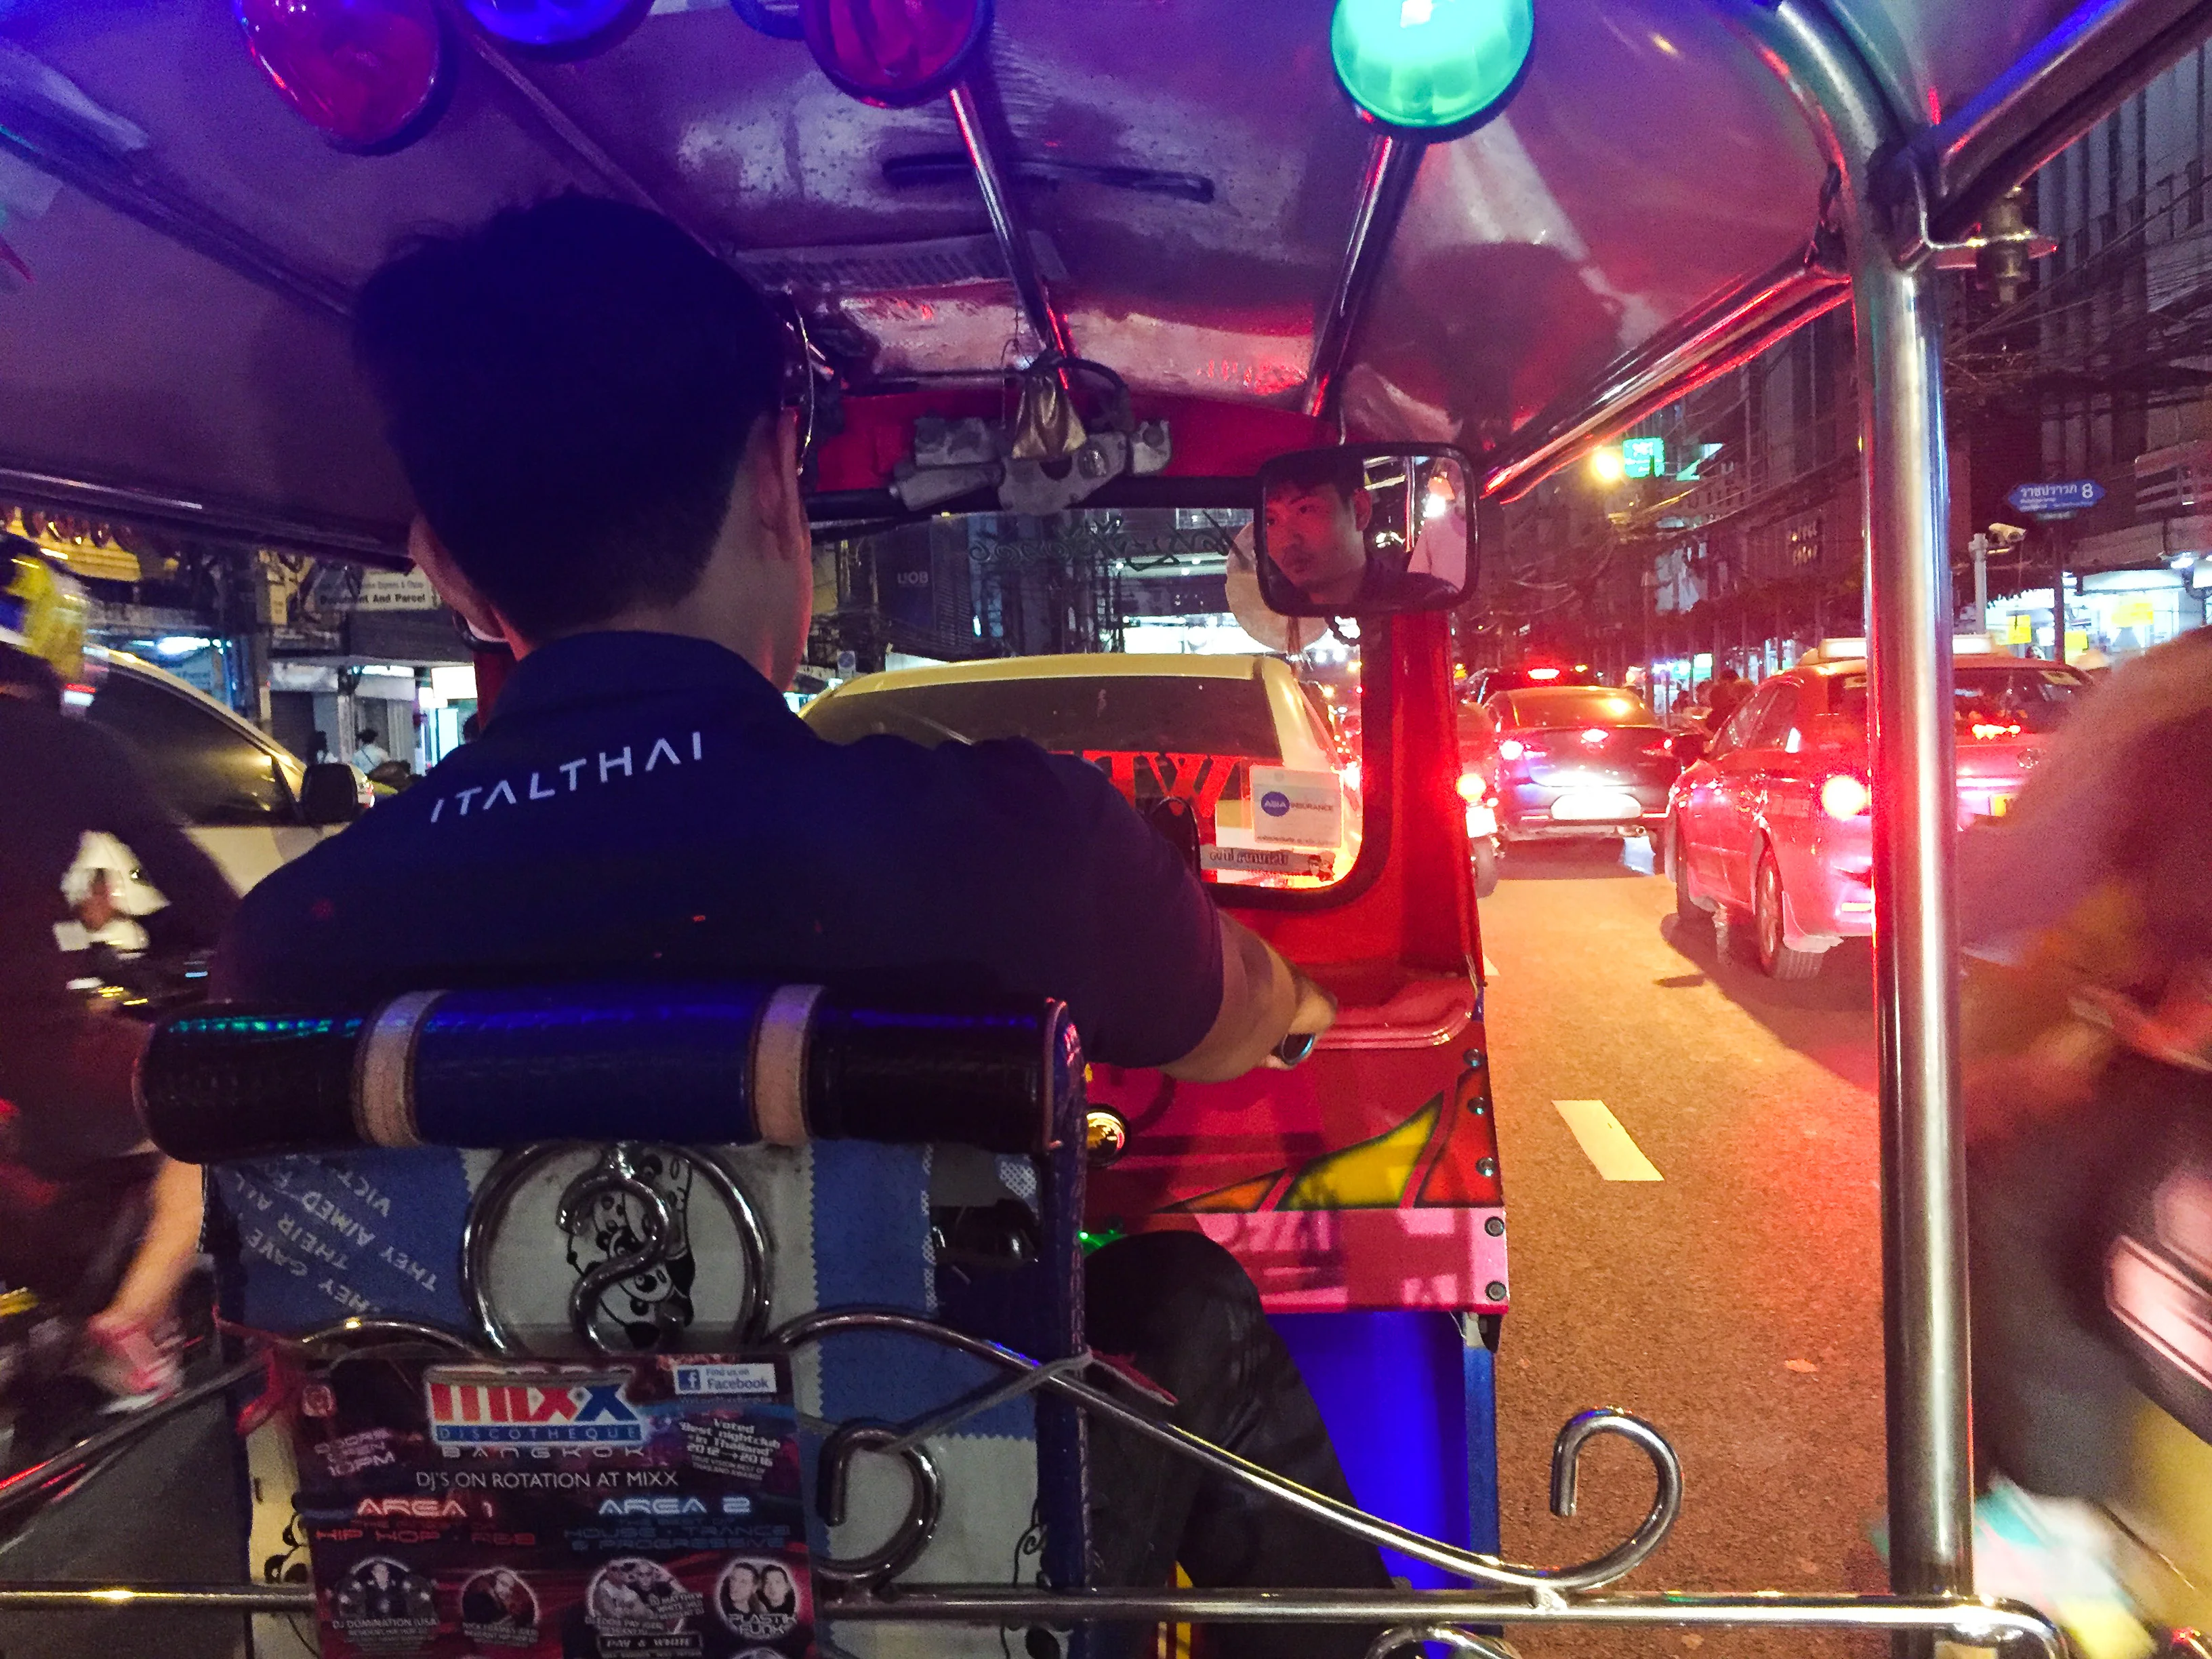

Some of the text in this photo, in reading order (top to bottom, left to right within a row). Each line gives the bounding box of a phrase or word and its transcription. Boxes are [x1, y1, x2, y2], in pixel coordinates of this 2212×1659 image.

[2082, 483, 2093, 499] 8
[897, 571, 928, 584] UOB
[373, 594, 391, 602] And
[394, 593, 426, 603] Parcel
[301, 1191, 376, 1248] AIMED
[277, 1212, 350, 1271] THEIR
[245, 1228, 381, 1313] HEY GAVE
[380, 1245, 437, 1292] THEY
[707, 1376, 769, 1390] Facebook
[439, 1427, 636, 1441] DISCOTHEQUE
[441, 1446, 644, 1458] BANGKOK
[416, 1471, 678, 1491] DJ'S ON ROTATION AT MIXX
[357, 1497, 493, 1518] AREA 1
[598, 1496, 751, 1515] AREA 2
[316, 1529, 363, 1541] HIP
[375, 1530, 441, 1544] HOP
[565, 1525, 790, 1538] HOUSE TRANCE
